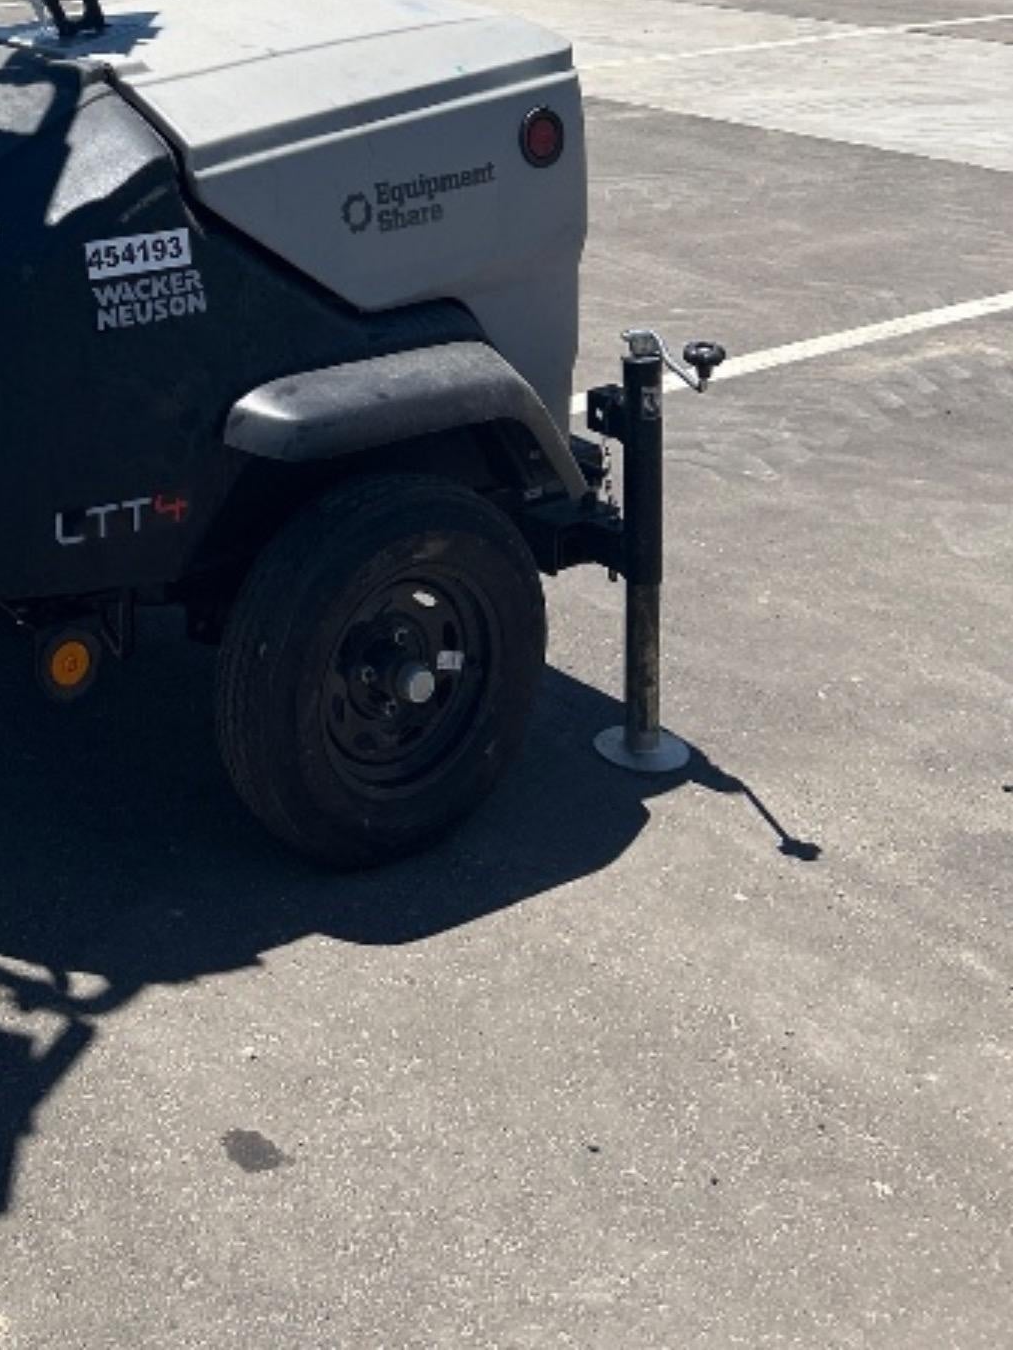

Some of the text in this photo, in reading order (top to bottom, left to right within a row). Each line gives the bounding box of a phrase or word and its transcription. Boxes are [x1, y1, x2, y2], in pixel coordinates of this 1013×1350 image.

[374, 161, 495, 207] Equipment
[376, 203, 444, 233] Share
[88, 236, 183, 270] 454193
[91, 270, 204, 307] WACKER
[97, 290, 207, 331] NEUSON
[55, 495, 187, 544] LTT4
